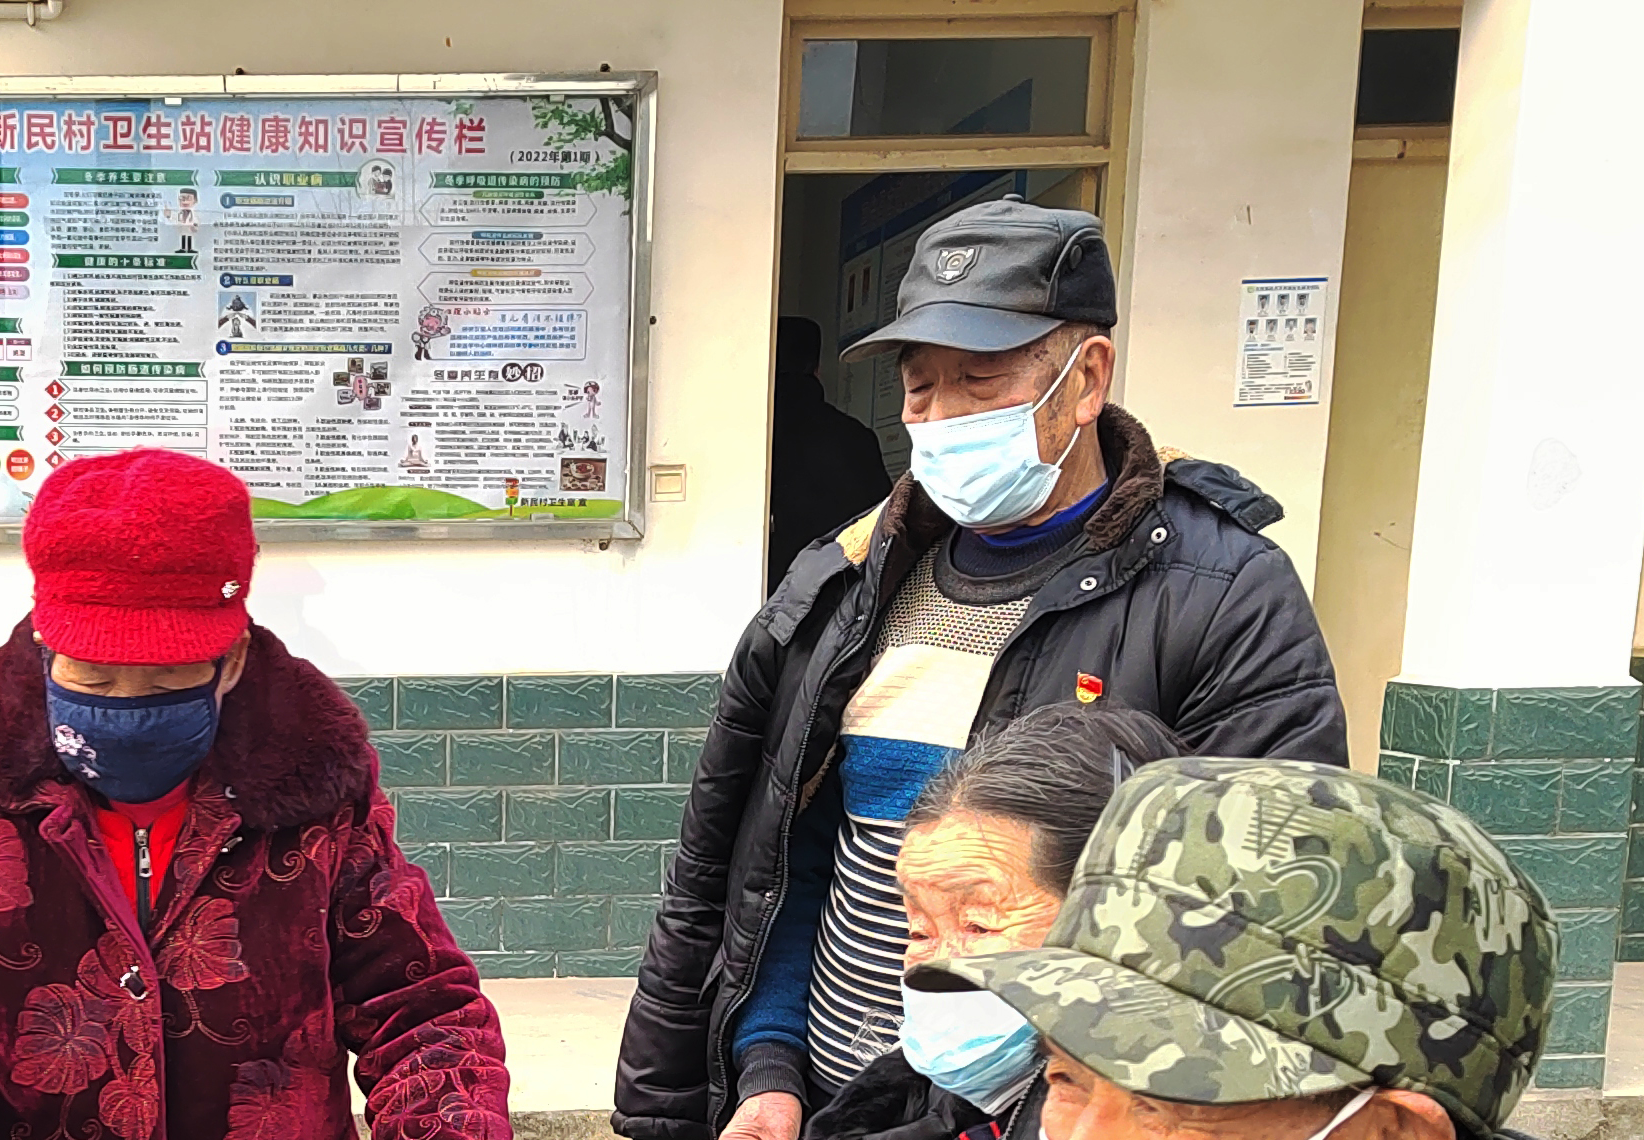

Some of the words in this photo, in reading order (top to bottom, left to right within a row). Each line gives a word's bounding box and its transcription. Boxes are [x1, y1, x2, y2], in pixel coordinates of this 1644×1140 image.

[255, 172, 323, 186] 认识职业病
[444, 175, 562, 187] 冬季呼吸道传染病的预防
[84, 255, 166, 267] 健康的十条标准
[80, 363, 186, 376] 如何预防肠道传染病
